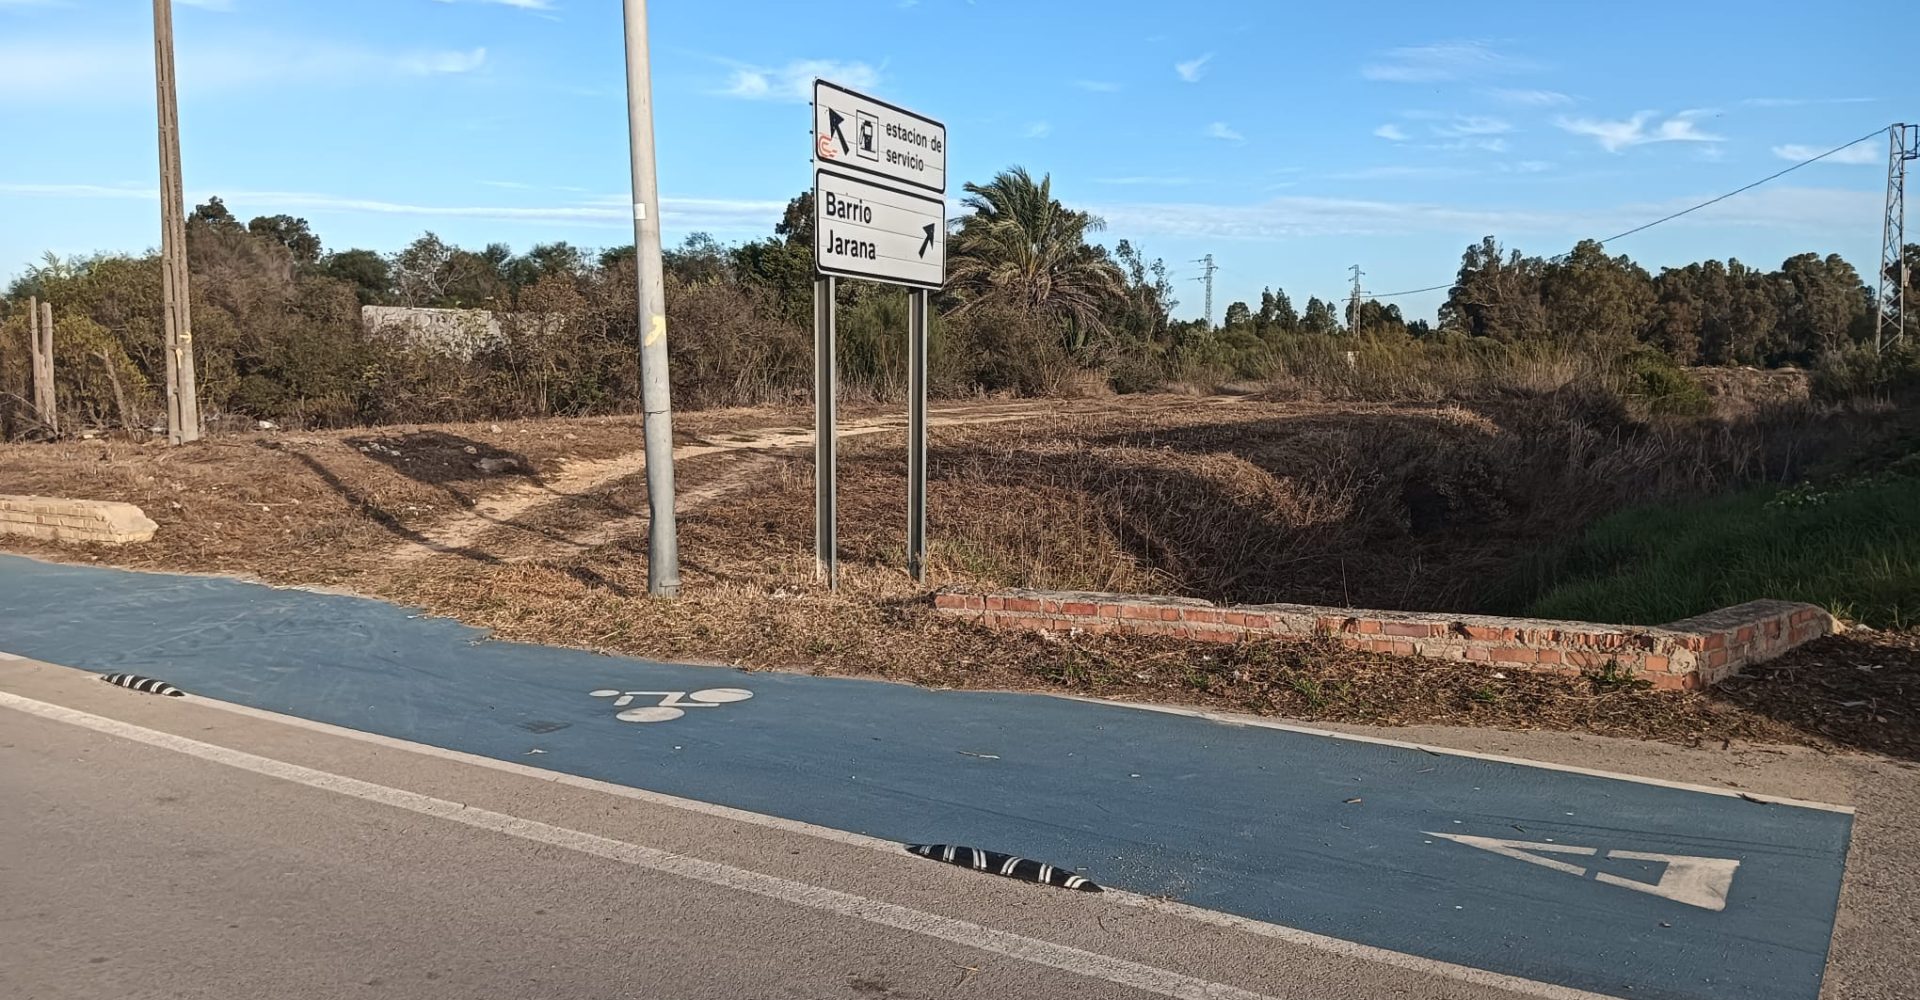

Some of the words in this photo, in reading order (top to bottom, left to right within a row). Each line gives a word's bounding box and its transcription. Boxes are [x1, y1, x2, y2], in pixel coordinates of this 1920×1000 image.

[886, 122, 928, 149] estacion
[930, 135, 942, 153] de
[886, 149, 924, 171] servicio
[826, 191, 872, 224] Barrio
[827, 229, 876, 260] Jarana
